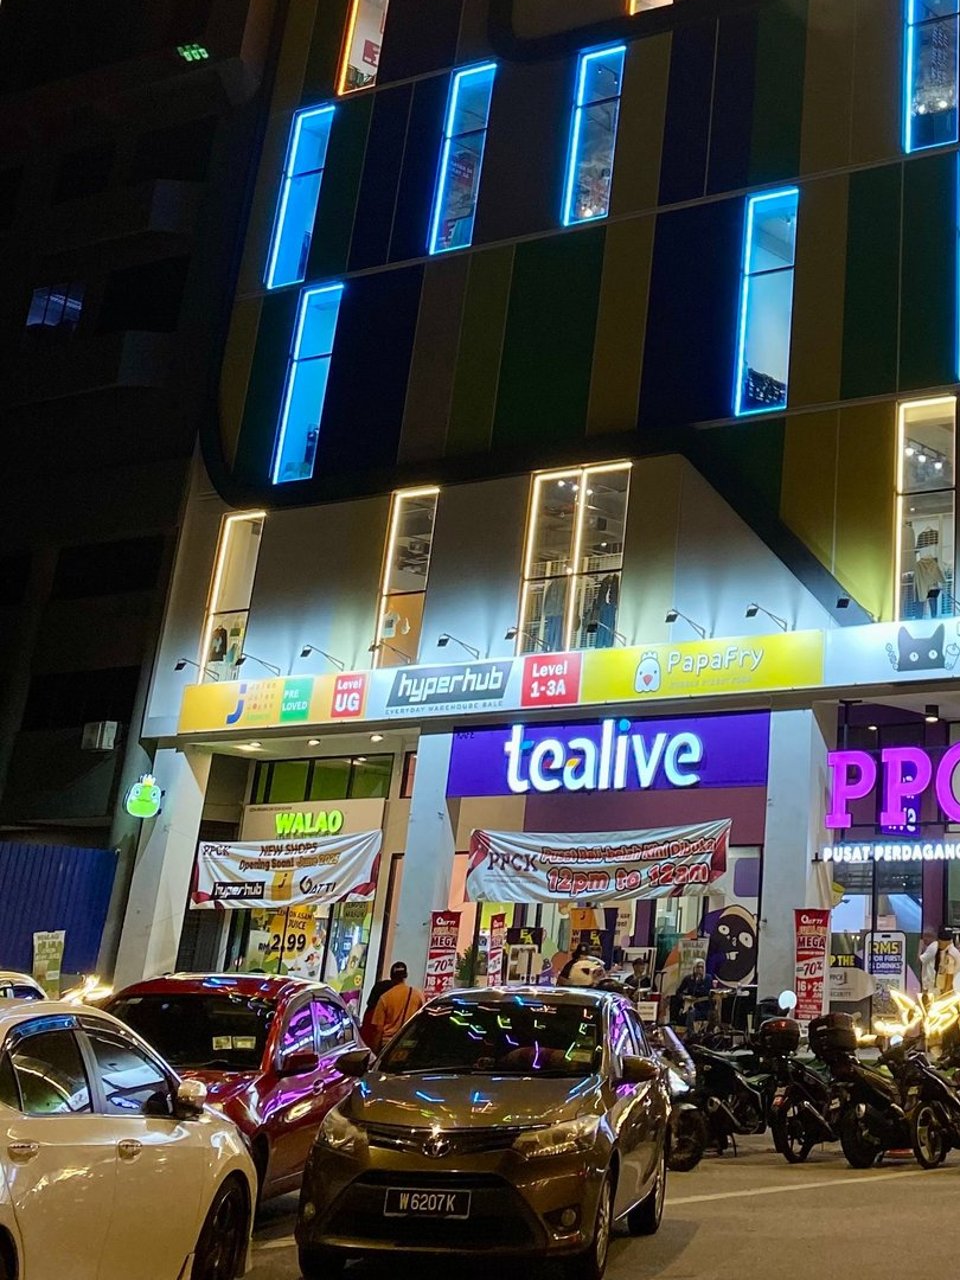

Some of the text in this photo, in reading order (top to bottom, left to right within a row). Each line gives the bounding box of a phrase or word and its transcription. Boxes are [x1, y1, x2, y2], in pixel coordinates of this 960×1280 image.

[667, 646, 764, 676] PapaFry
[532, 661, 568, 678] Level
[337, 679, 363, 690] Level
[398, 665, 503, 702] hyperhub
[284, 689, 299, 699] PRE
[282, 701, 308, 712] LOVED
[335, 693, 361, 712] UG
[385, 700, 502, 715] EVERYDAY WAREHOUSE SALE
[504, 718, 702, 793] tealive
[275, 810, 344, 834] WALAO
[203, 845, 231, 857] PPCK
[259, 842, 318, 856] NEW SHOPS
[669, 837, 717, 858] Dibuka
[823, 846, 871, 863] PUSAT
[488, 851, 539, 872] PPCK
[547, 867, 609, 896] 12pm
[615, 868, 641, 891] to
[648, 862, 710, 886] 12am
[214, 882, 263, 898] hyperhub
[287, 919, 307, 930] JUICE
[271, 933, 307, 951] 2.99
[432, 936, 457, 948] MEGA
[797, 936, 826, 949] MEGA
[837, 955, 855, 966] THE
